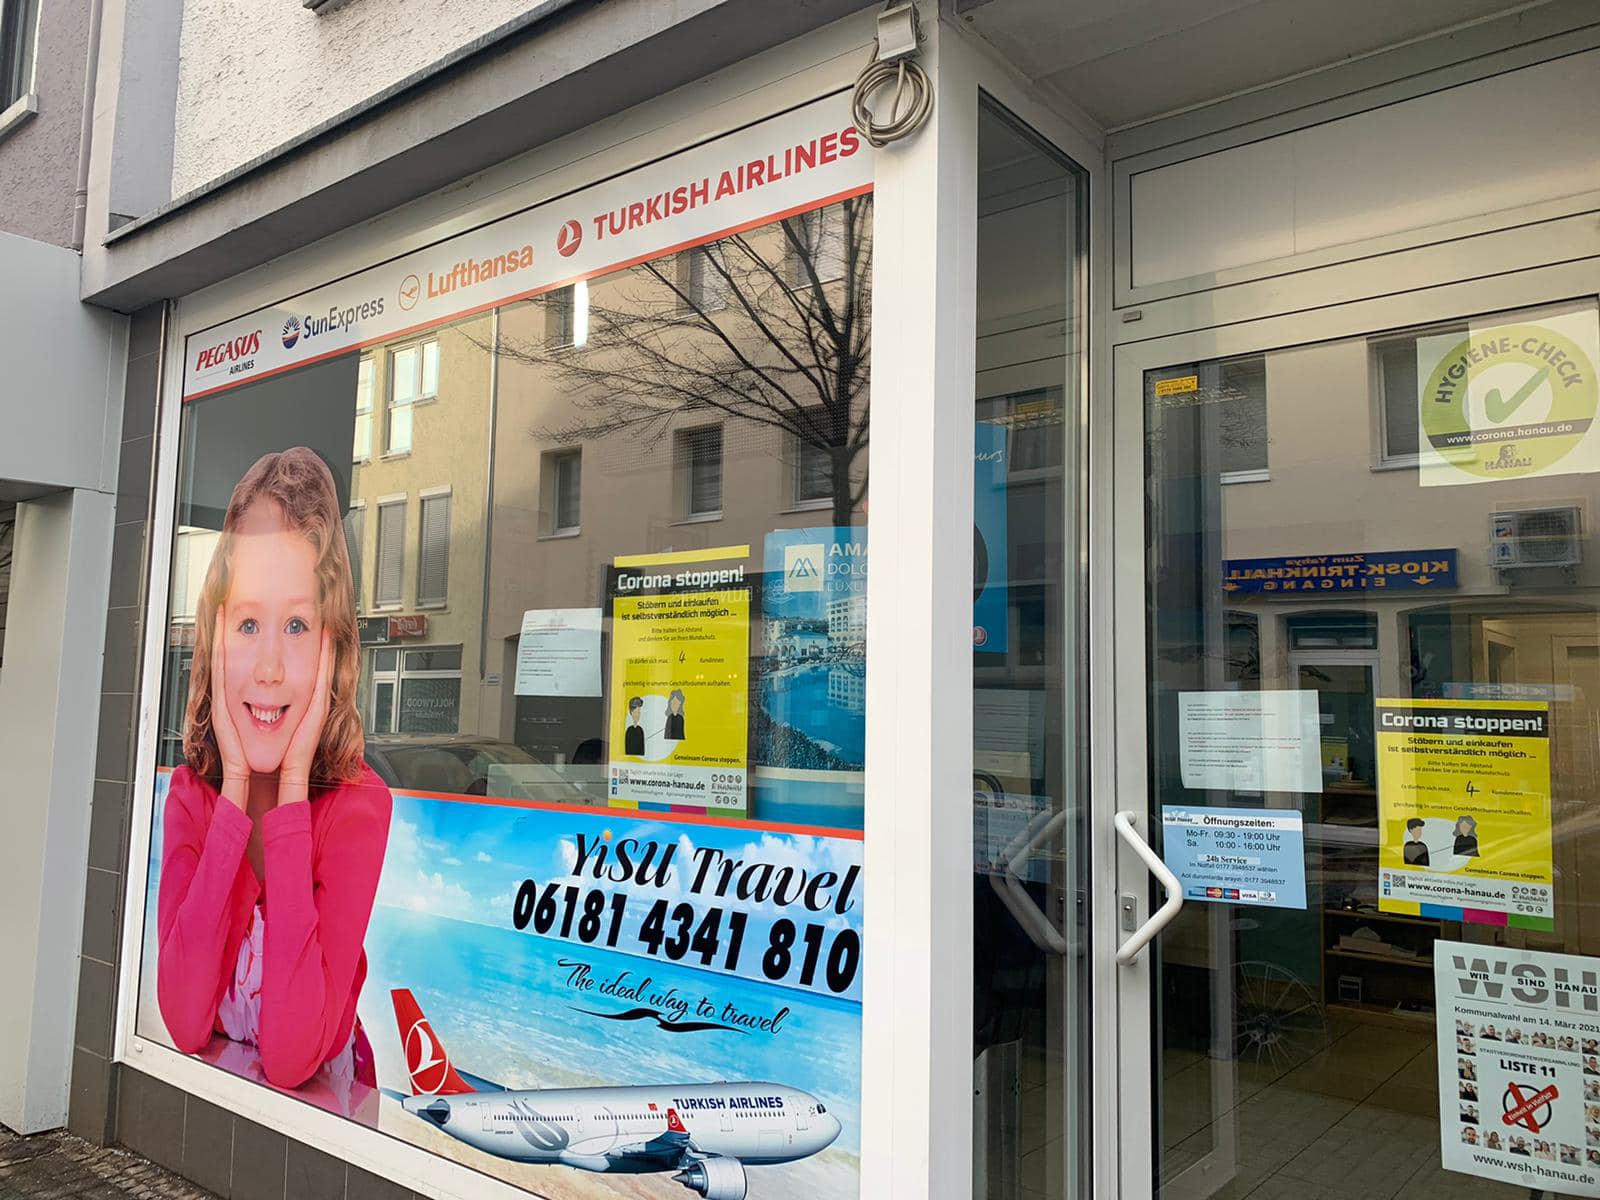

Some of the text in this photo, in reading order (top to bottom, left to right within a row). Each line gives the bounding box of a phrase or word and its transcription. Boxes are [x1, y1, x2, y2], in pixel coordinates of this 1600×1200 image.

[593, 126, 860, 241] TURKISH AIRLINES
[426, 245, 534, 298] Lufthansa
[303, 297, 384, 340] SunExpress
[195, 329, 262, 372] PEGASUS
[228, 359, 255, 376] AIRLINES
[1434, 336, 1584, 404] HYGIENE-CHECK
[1447, 422, 1573, 444] www.corona.hanau.de
[1484, 456, 1532, 471] HANAU
[617, 564, 744, 591] Corona stoppen!
[637, 597, 719, 610] Stöbern und einkaufen
[621, 612, 631, 621] ist
[631, 609, 699, 621] selbstverständlich
[699, 608, 729, 620] möglich
[678, 650, 686, 664] 4
[1381, 712, 1543, 733] Corona stoppen!
[1407, 736, 1513, 748] Stöbern und einkaufen
[1388, 745, 1399, 753] ist
[1401, 745, 1487, 757] selbstverständlich
[1488, 749, 1527, 759] möglich
[629, 778, 706, 791] www.corona-hanau.de
[1465, 780, 1480, 798] 4
[1203, 816, 1275, 828] Öffnungszeiten:
[1186, 829, 1210, 838] Mo-Fr.
[1213, 830, 1235, 839] 09:30
[1243, 832, 1264, 840] 19:00
[1265, 832, 1280, 841] Uhr
[1186, 839, 1199, 847] Sa.
[1215, 840, 1236, 849] 10:00
[1243, 842, 1264, 851] 16:00
[1266, 842, 1281, 851] Uhr
[1206, 854, 1247, 864] 24h Service
[689, 845, 862, 915] Travel
[1407, 883, 1506, 899] www.corona-hanau.de
[512, 878, 861, 993] 06181 4341 810
[1469, 971, 1598, 994] WIR SIND HANAU
[557, 958, 789, 1035] The ideal way to travel
[1454, 1005, 1600, 1034] Kommunalwahl am 14. März 2021
[1499, 1058, 1556, 1078] LISTE 11
[672, 1095, 784, 1110] TURKISH AIRLINES
[1473, 1153, 1595, 1184] www.wsh-hanau.de
